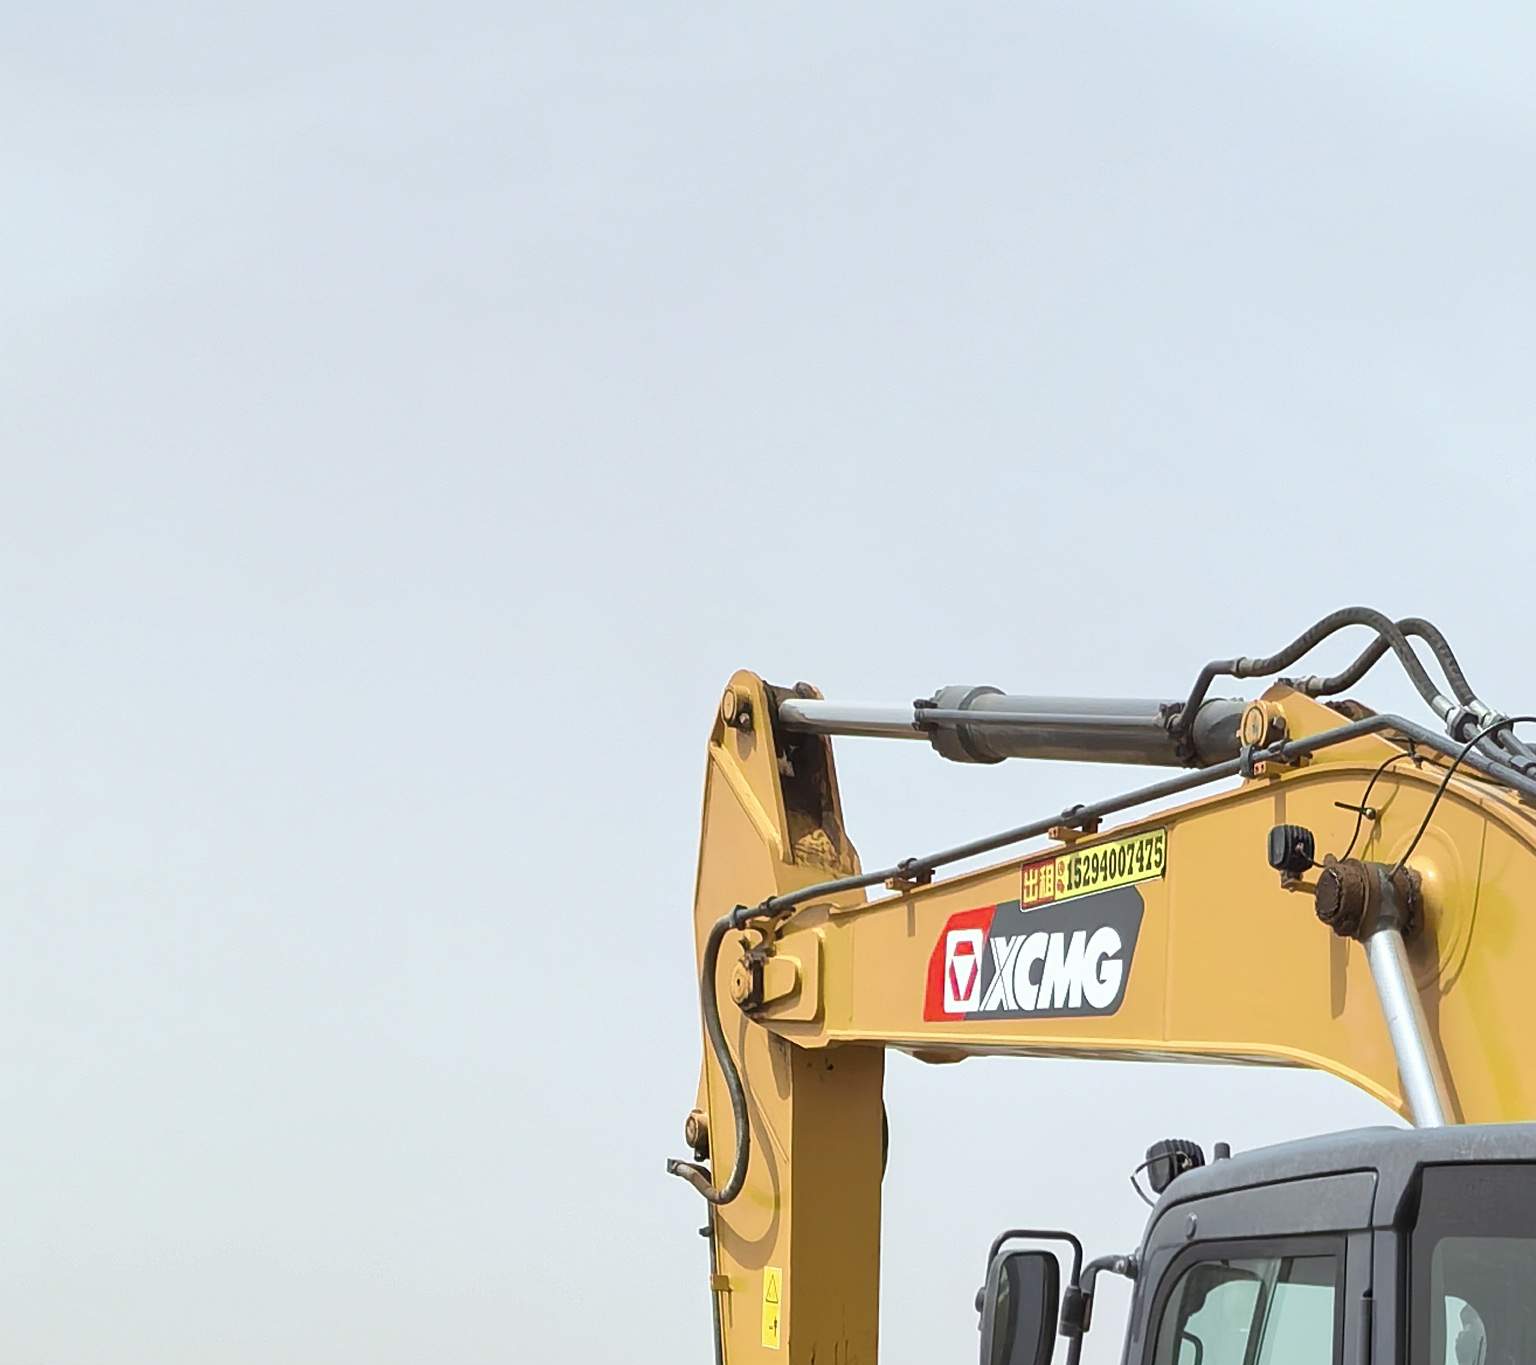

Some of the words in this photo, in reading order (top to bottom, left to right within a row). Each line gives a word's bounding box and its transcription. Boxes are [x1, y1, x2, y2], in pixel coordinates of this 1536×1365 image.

[1023, 864, 1055, 904] 出租
[1066, 836, 1164, 891] 15294007475
[978, 926, 1123, 1012] XCMG
